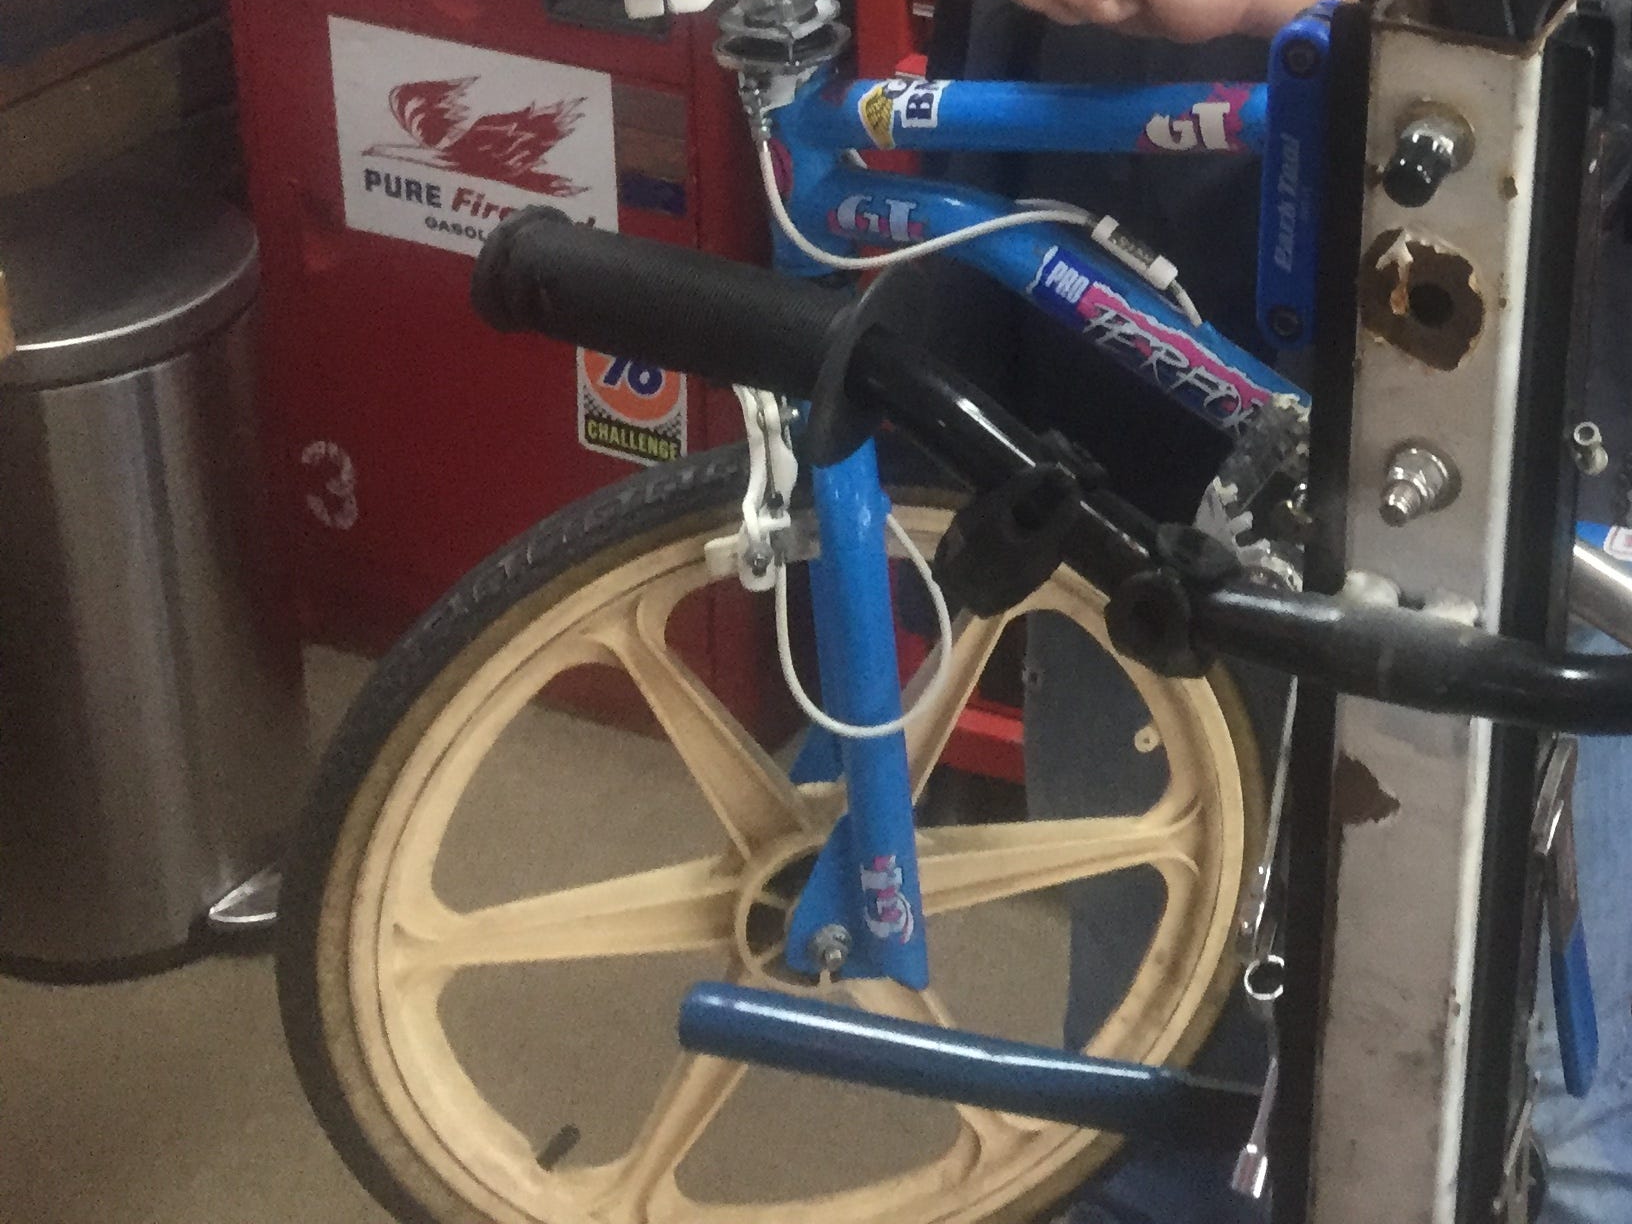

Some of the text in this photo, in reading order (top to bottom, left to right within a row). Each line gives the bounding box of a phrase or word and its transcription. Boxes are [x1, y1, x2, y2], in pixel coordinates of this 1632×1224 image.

[1146, 102, 1230, 150] GT
[364, 168, 442, 209] PURE
[424, 214, 487, 242] GASOL
[837, 194, 917, 242] GT
[1045, 260, 1090, 304] PRO
[587, 419, 679, 461] CHALLENGE
